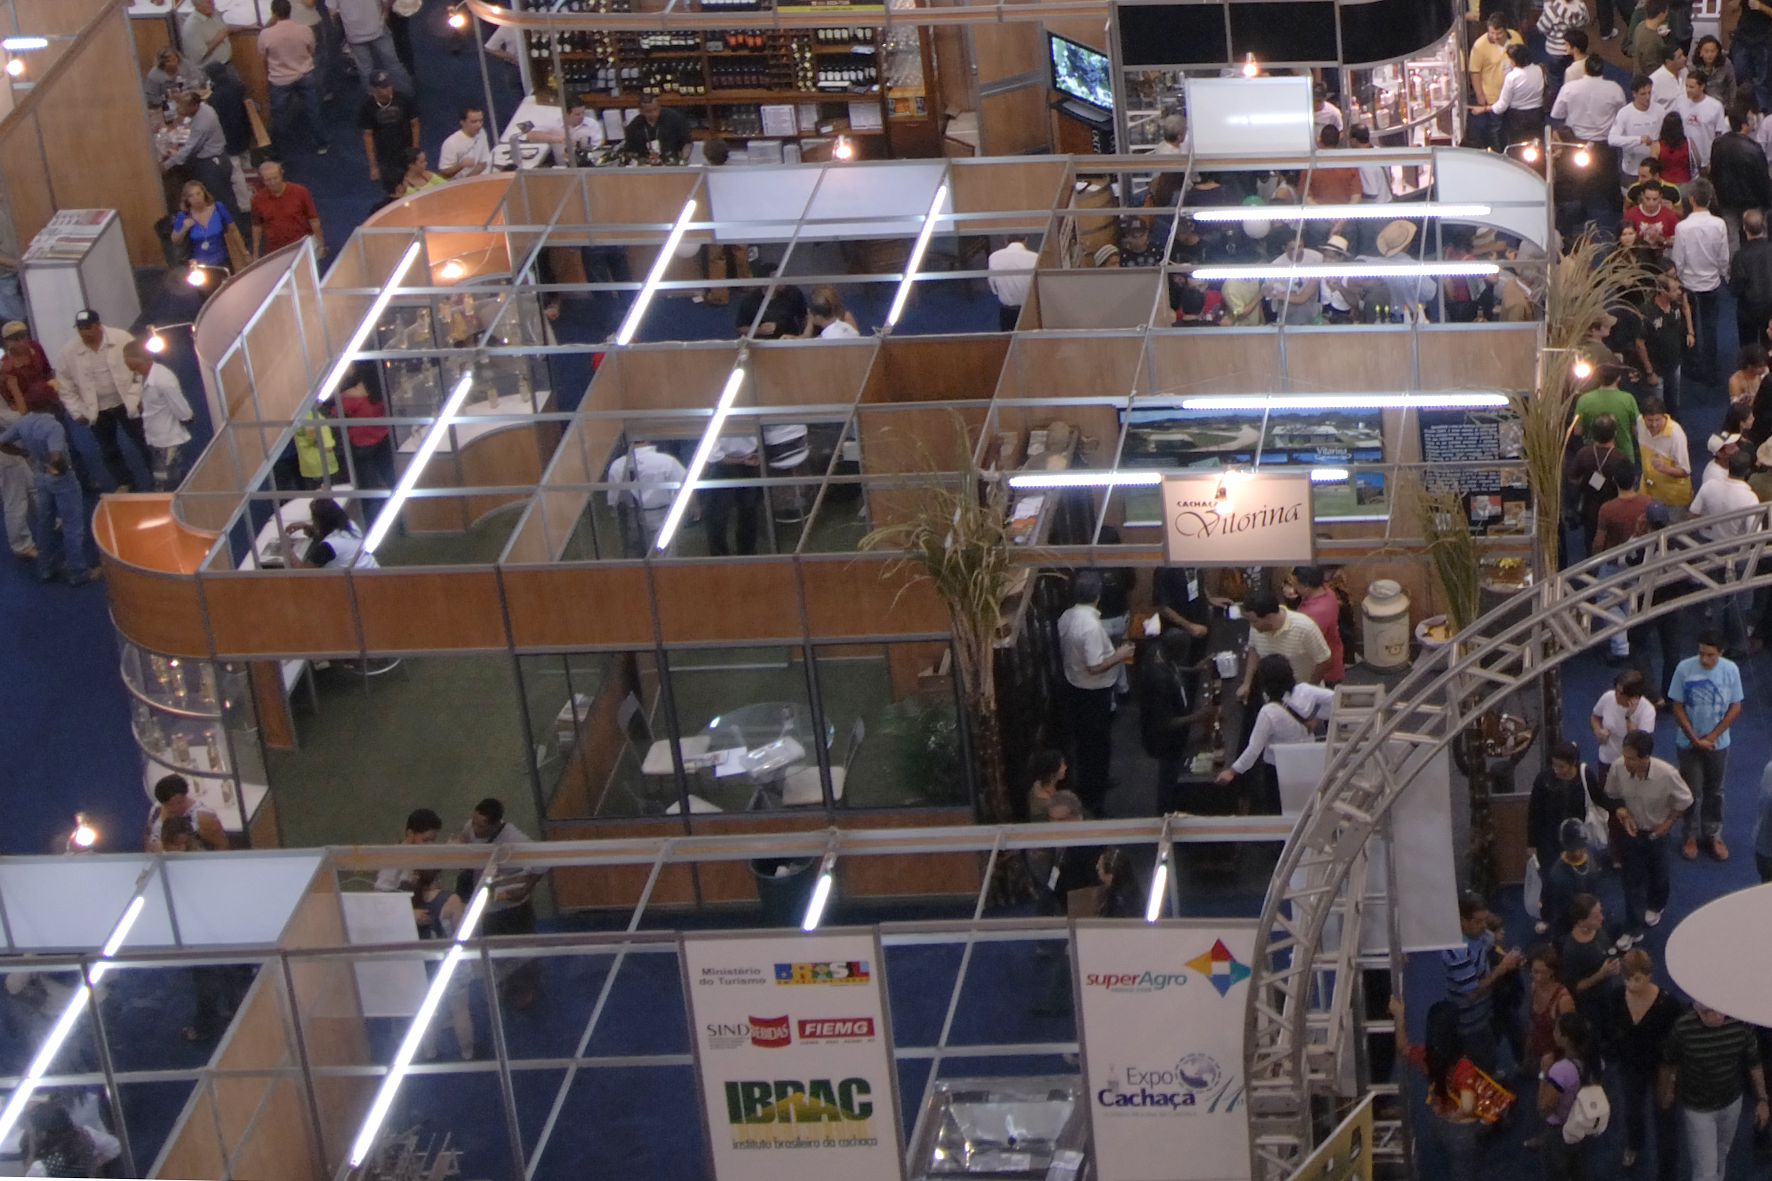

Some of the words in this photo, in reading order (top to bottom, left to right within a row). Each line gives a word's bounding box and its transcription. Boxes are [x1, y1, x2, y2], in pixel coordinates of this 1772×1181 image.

[1316, 447, 1348, 455] Vitorina
[1175, 503, 1302, 539] Vitorina
[702, 966, 762, 977] Ministério
[699, 977, 709, 986] do
[719, 977, 767, 986] Turismo
[1086, 971, 1189, 991] superAgro
[805, 1021, 869, 1036] FIEMG
[1127, 1067, 1174, 1090] Expo
[724, 1077, 874, 1125] IBRAC
[1097, 1088, 1196, 1110] Cachaça
[732, 1137, 772, 1150] instituto
[774, 1136, 821, 1149] brasileiro
